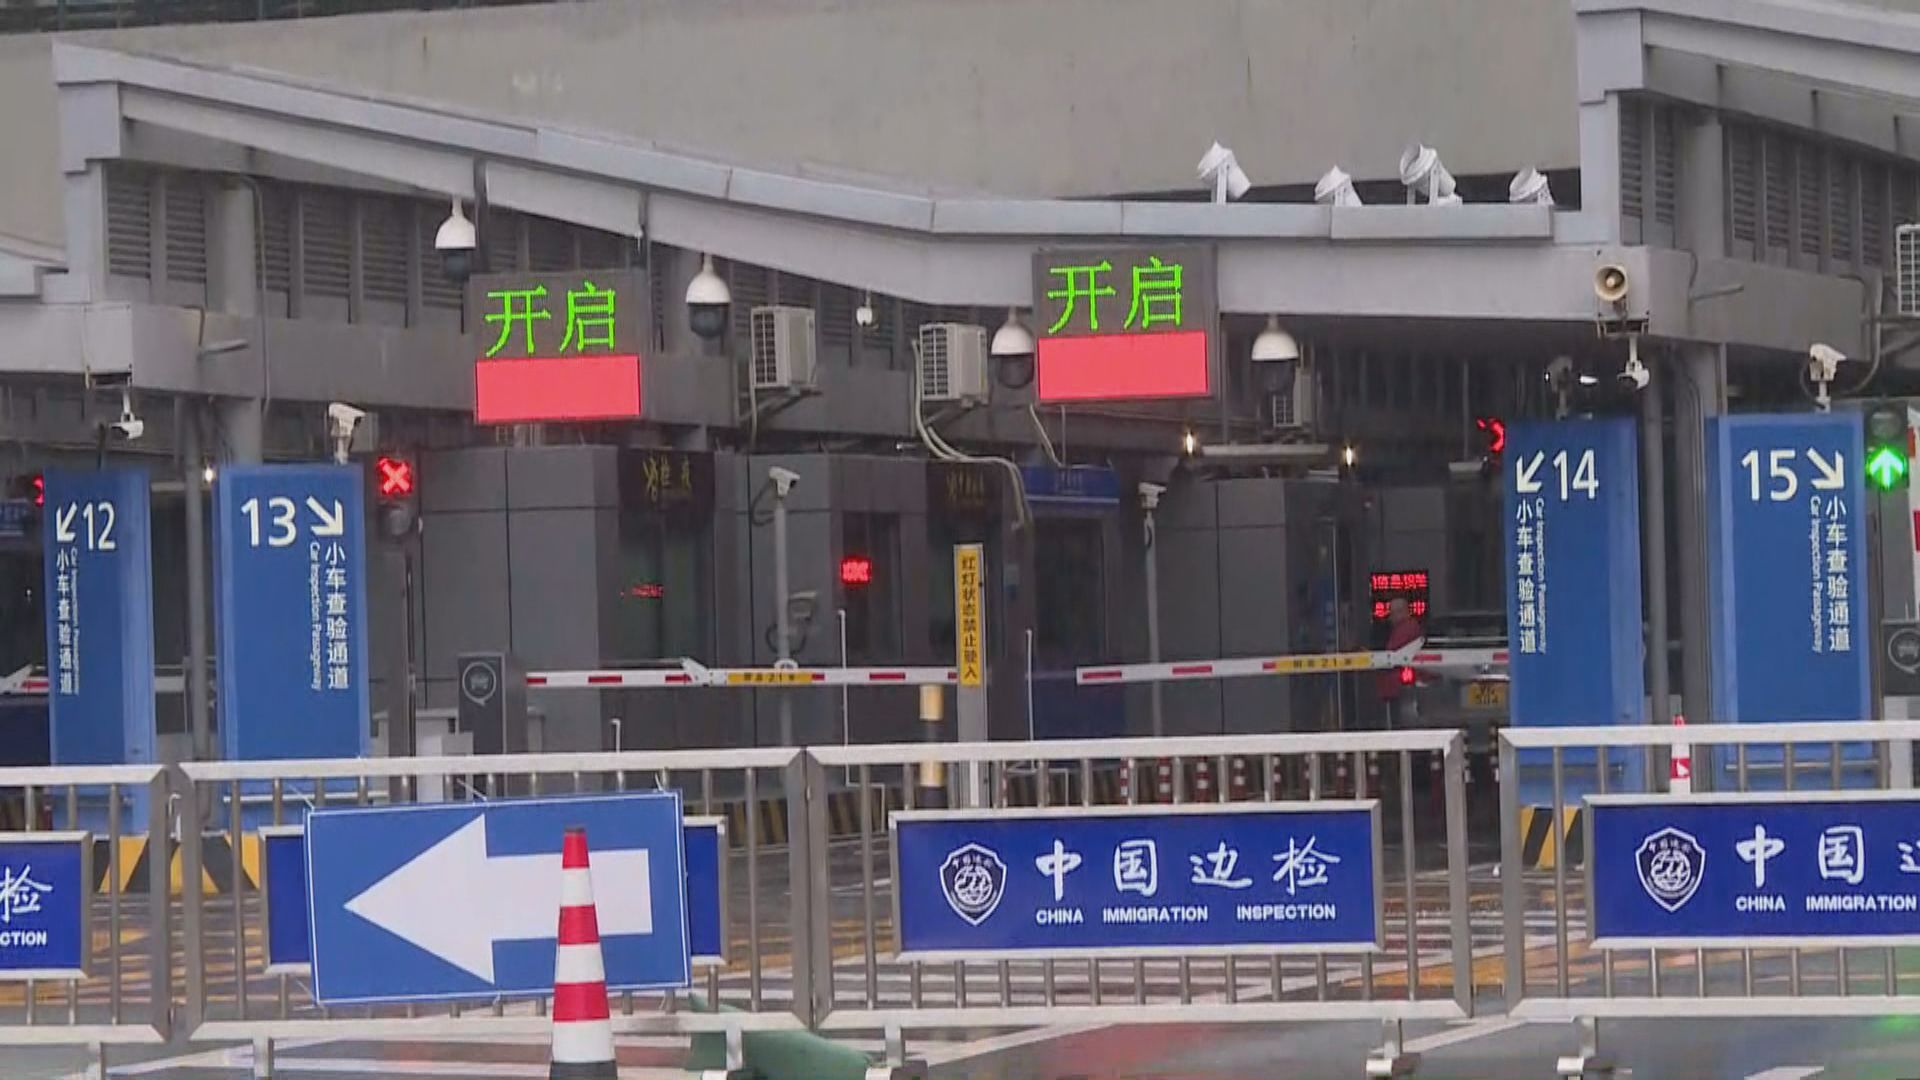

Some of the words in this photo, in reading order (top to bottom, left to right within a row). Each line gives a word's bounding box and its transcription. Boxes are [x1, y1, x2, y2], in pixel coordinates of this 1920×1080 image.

[485, 281, 616, 356] 开启
[1047, 257, 1183, 333] 开启
[1552, 450, 1599, 500] 14
[1741, 449, 1798, 501] 15
[82, 502, 116, 551] 12
[241, 497, 298, 547] 13
[1535, 497, 1545, 519] Car
[1810, 495, 1821, 517] Car
[309, 541, 321, 562] Car
[1809, 518, 1822, 580] Inspection
[1825, 495, 1850, 651] 小车查验通道
[309, 563, 322, 621] Inspection
[1516, 499, 1536, 653] 小车查验通道
[325, 541, 349, 689] 小车查验通道
[1035, 834, 1340, 902] 中国边检
[1035, 907, 1084, 925] CHINA
[1102, 904, 1209, 923] IMMIGRATION
[1236, 903, 1337, 922] INSPECTION
[1735, 895, 1786, 912] CHINA
[1805, 894, 1918, 912] IMMIGRATION
